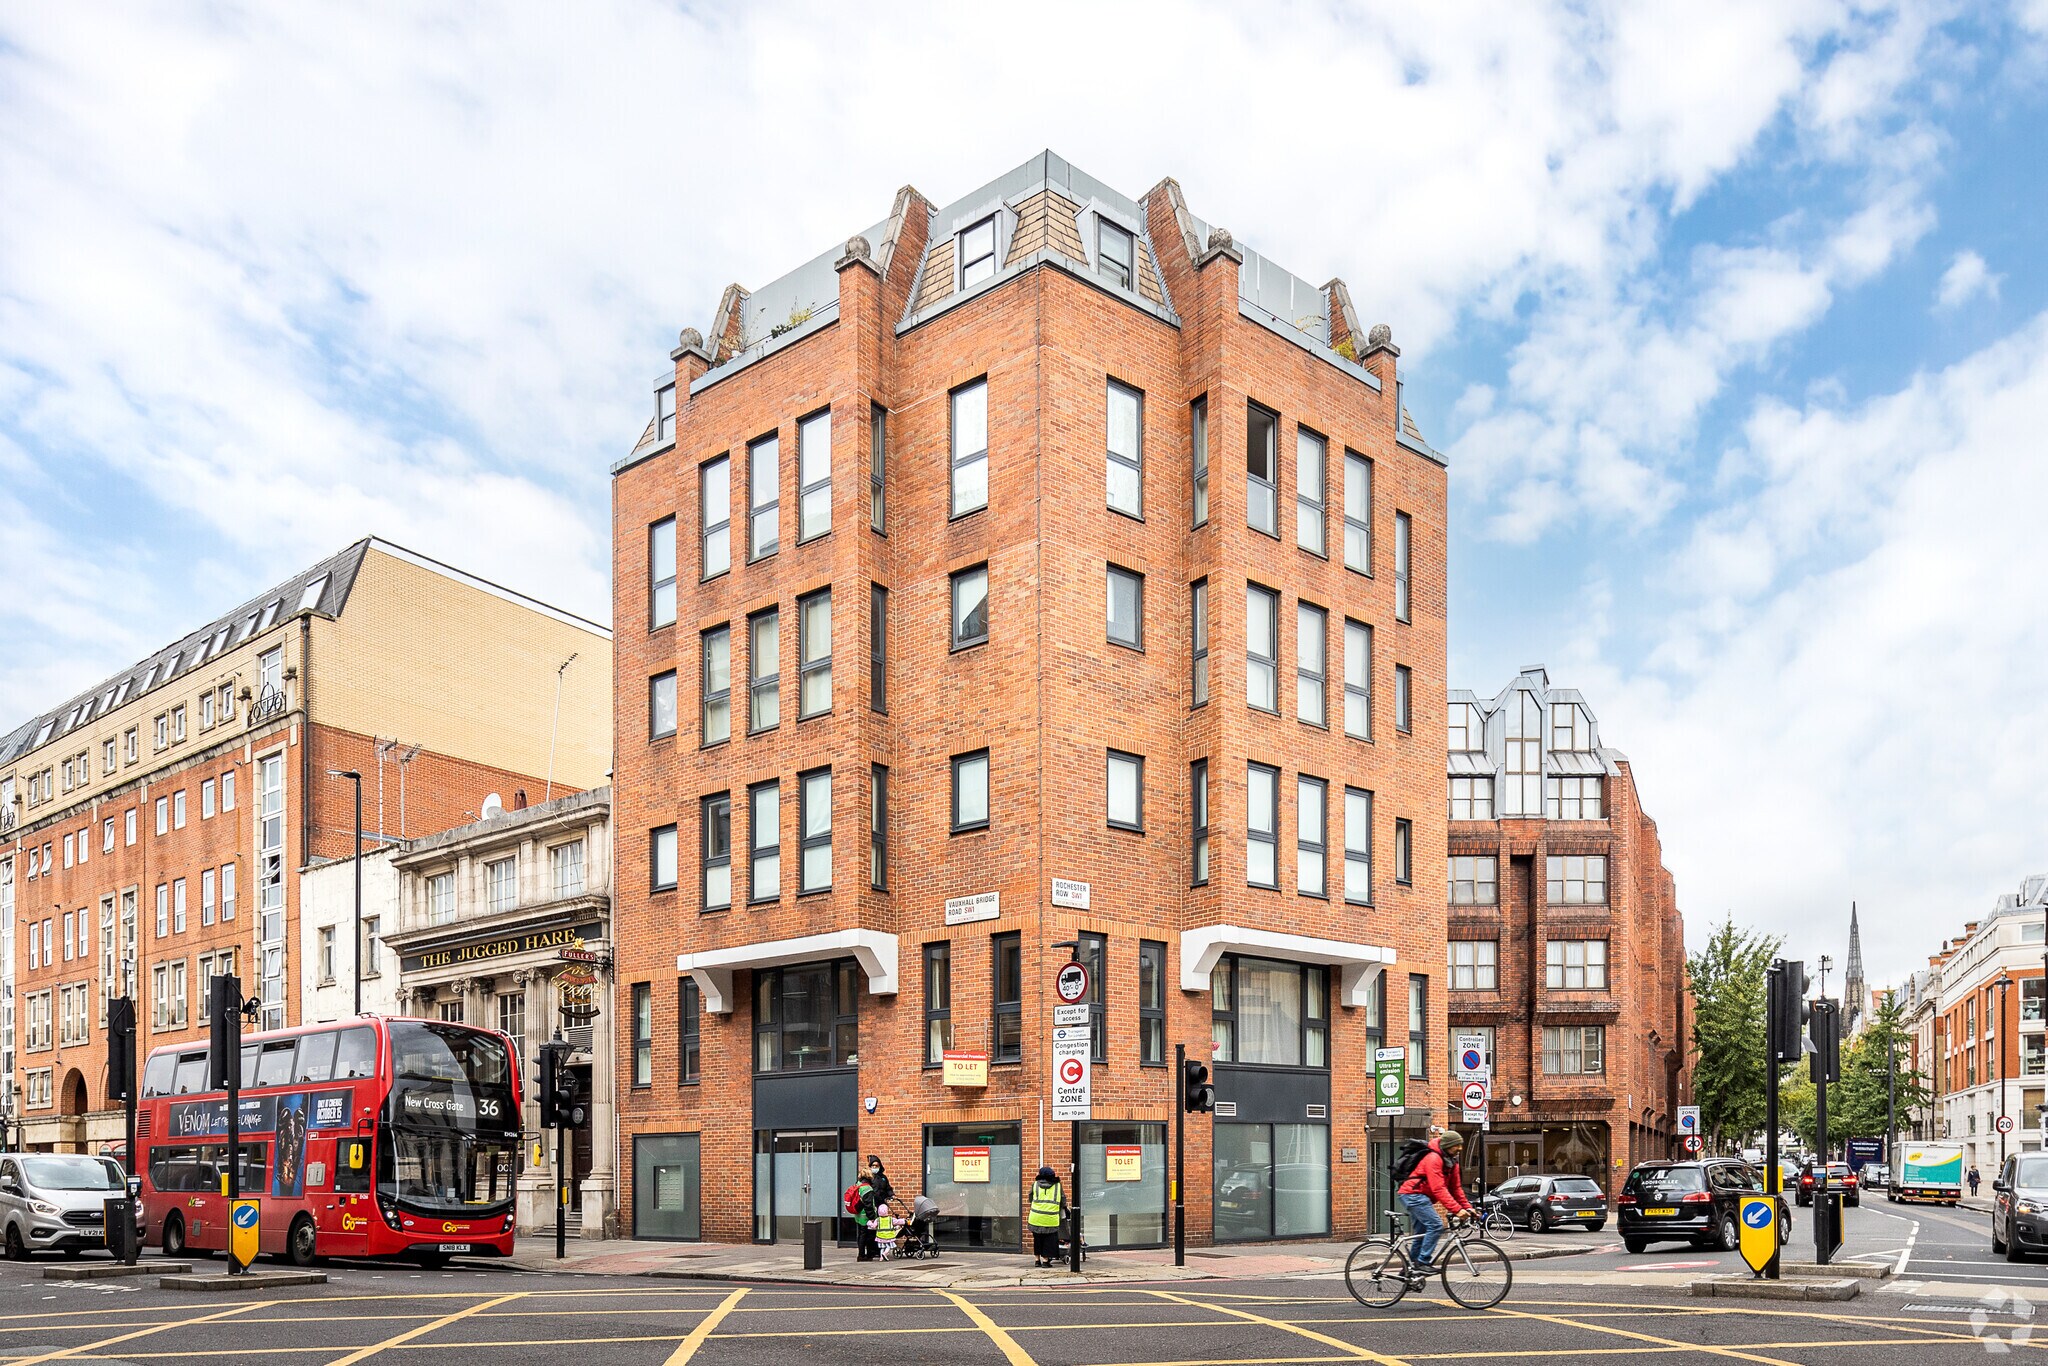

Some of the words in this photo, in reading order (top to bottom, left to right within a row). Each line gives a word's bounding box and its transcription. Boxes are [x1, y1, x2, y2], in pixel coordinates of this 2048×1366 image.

[1056, 881, 1087, 892] ROCHESTER
[1056, 889, 1069, 897] ROW
[1071, 891, 1083, 899] SW1
[949, 898, 974, 908] VAUXHALL
[976, 894, 996, 904] BRIDGE
[948, 908, 963, 916] ROAD
[964, 906, 975, 915] SW1
[420, 951, 451, 968] THE
[457, 939, 519, 961] JUGGED
[525, 928, 576, 950] HARE
[564, 950, 594, 960] FULLER'S
[1057, 1086, 1086, 1095] Central
[405, 1095, 421, 1107] New
[424, 1097, 444, 1110] Cross
[446, 1099, 464, 1112] Gate
[1060, 1095, 1083, 1103] ZONE
[1381, 1097, 1399, 1105] ZONE
[479, 1098, 499, 1116] 36
[316, 1107, 336, 1121] OCTOBER
[336, 1106, 342, 1119] 15
[178, 1104, 211, 1136] VENOM
[211, 1117, 220, 1127] LET
[2000, 1120, 2012, 1129] 20
[1687, 1139, 1700, 1148] 20
[342, 1212, 356, 1231] Go
[442, 1221, 458, 1233] Go
